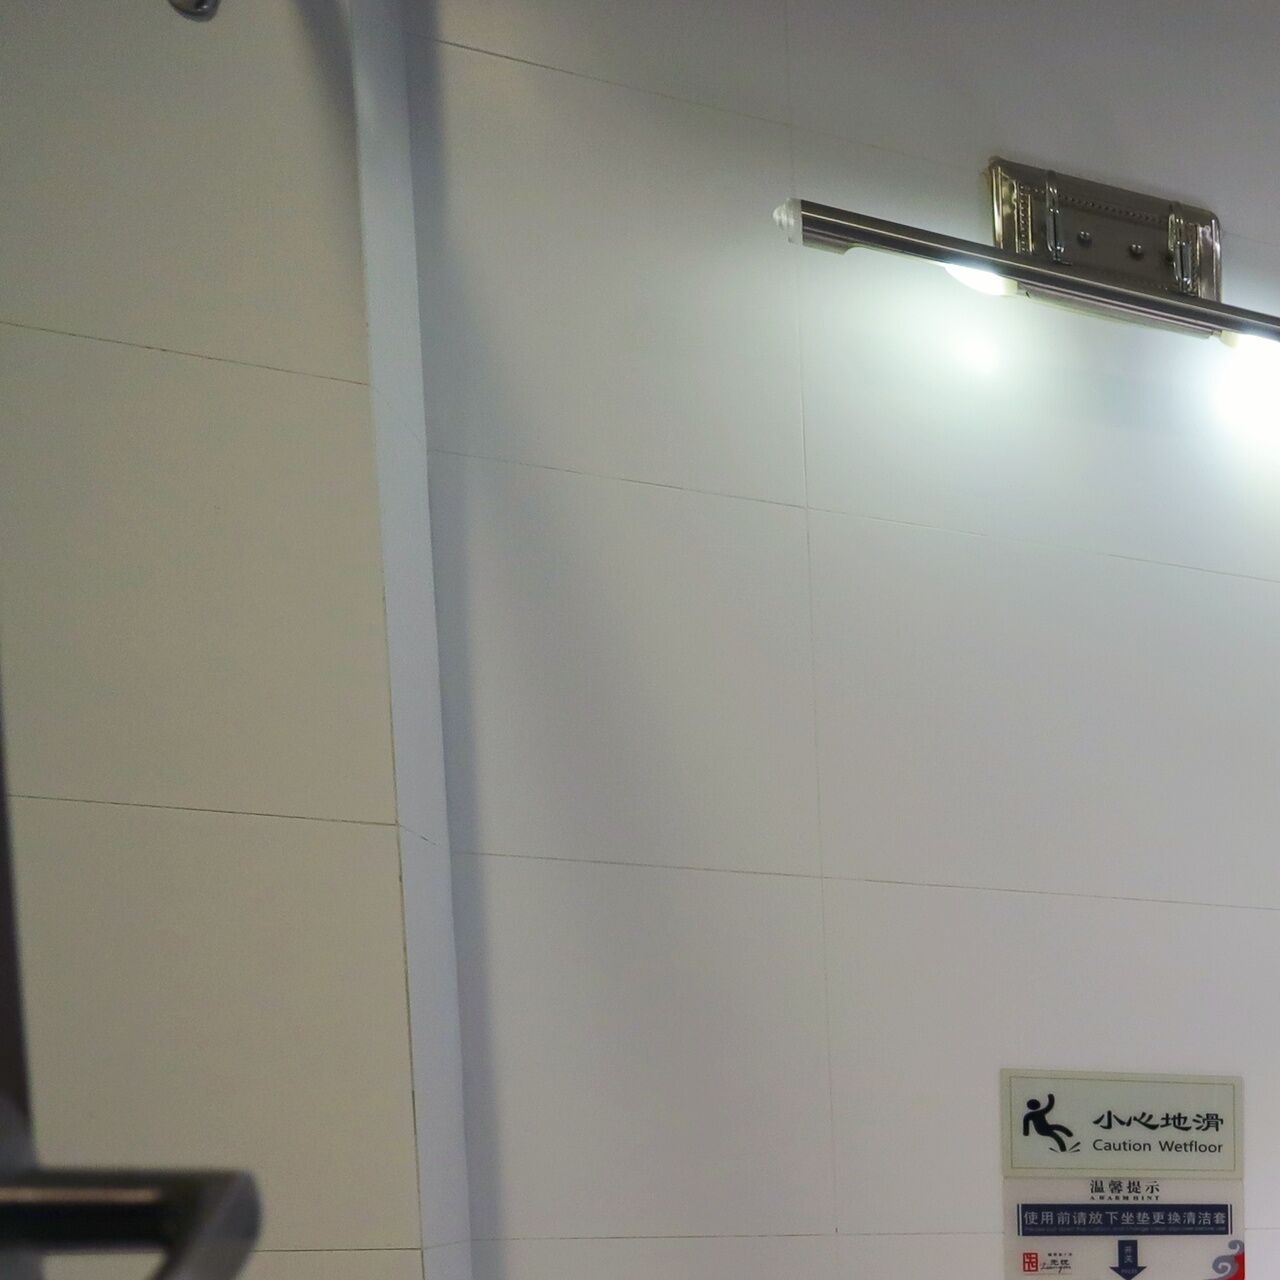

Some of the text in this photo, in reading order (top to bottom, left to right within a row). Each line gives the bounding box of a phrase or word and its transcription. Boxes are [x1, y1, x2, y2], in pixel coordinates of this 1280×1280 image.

[1092, 1109, 1224, 1132] 小心地滑
[1092, 1138, 1224, 1153] Caution Wetfloor
[1089, 1179, 1160, 1194] 温馨提示
[1024, 1211, 1227, 1226] 使用前请放下坐垫更换清洁套
